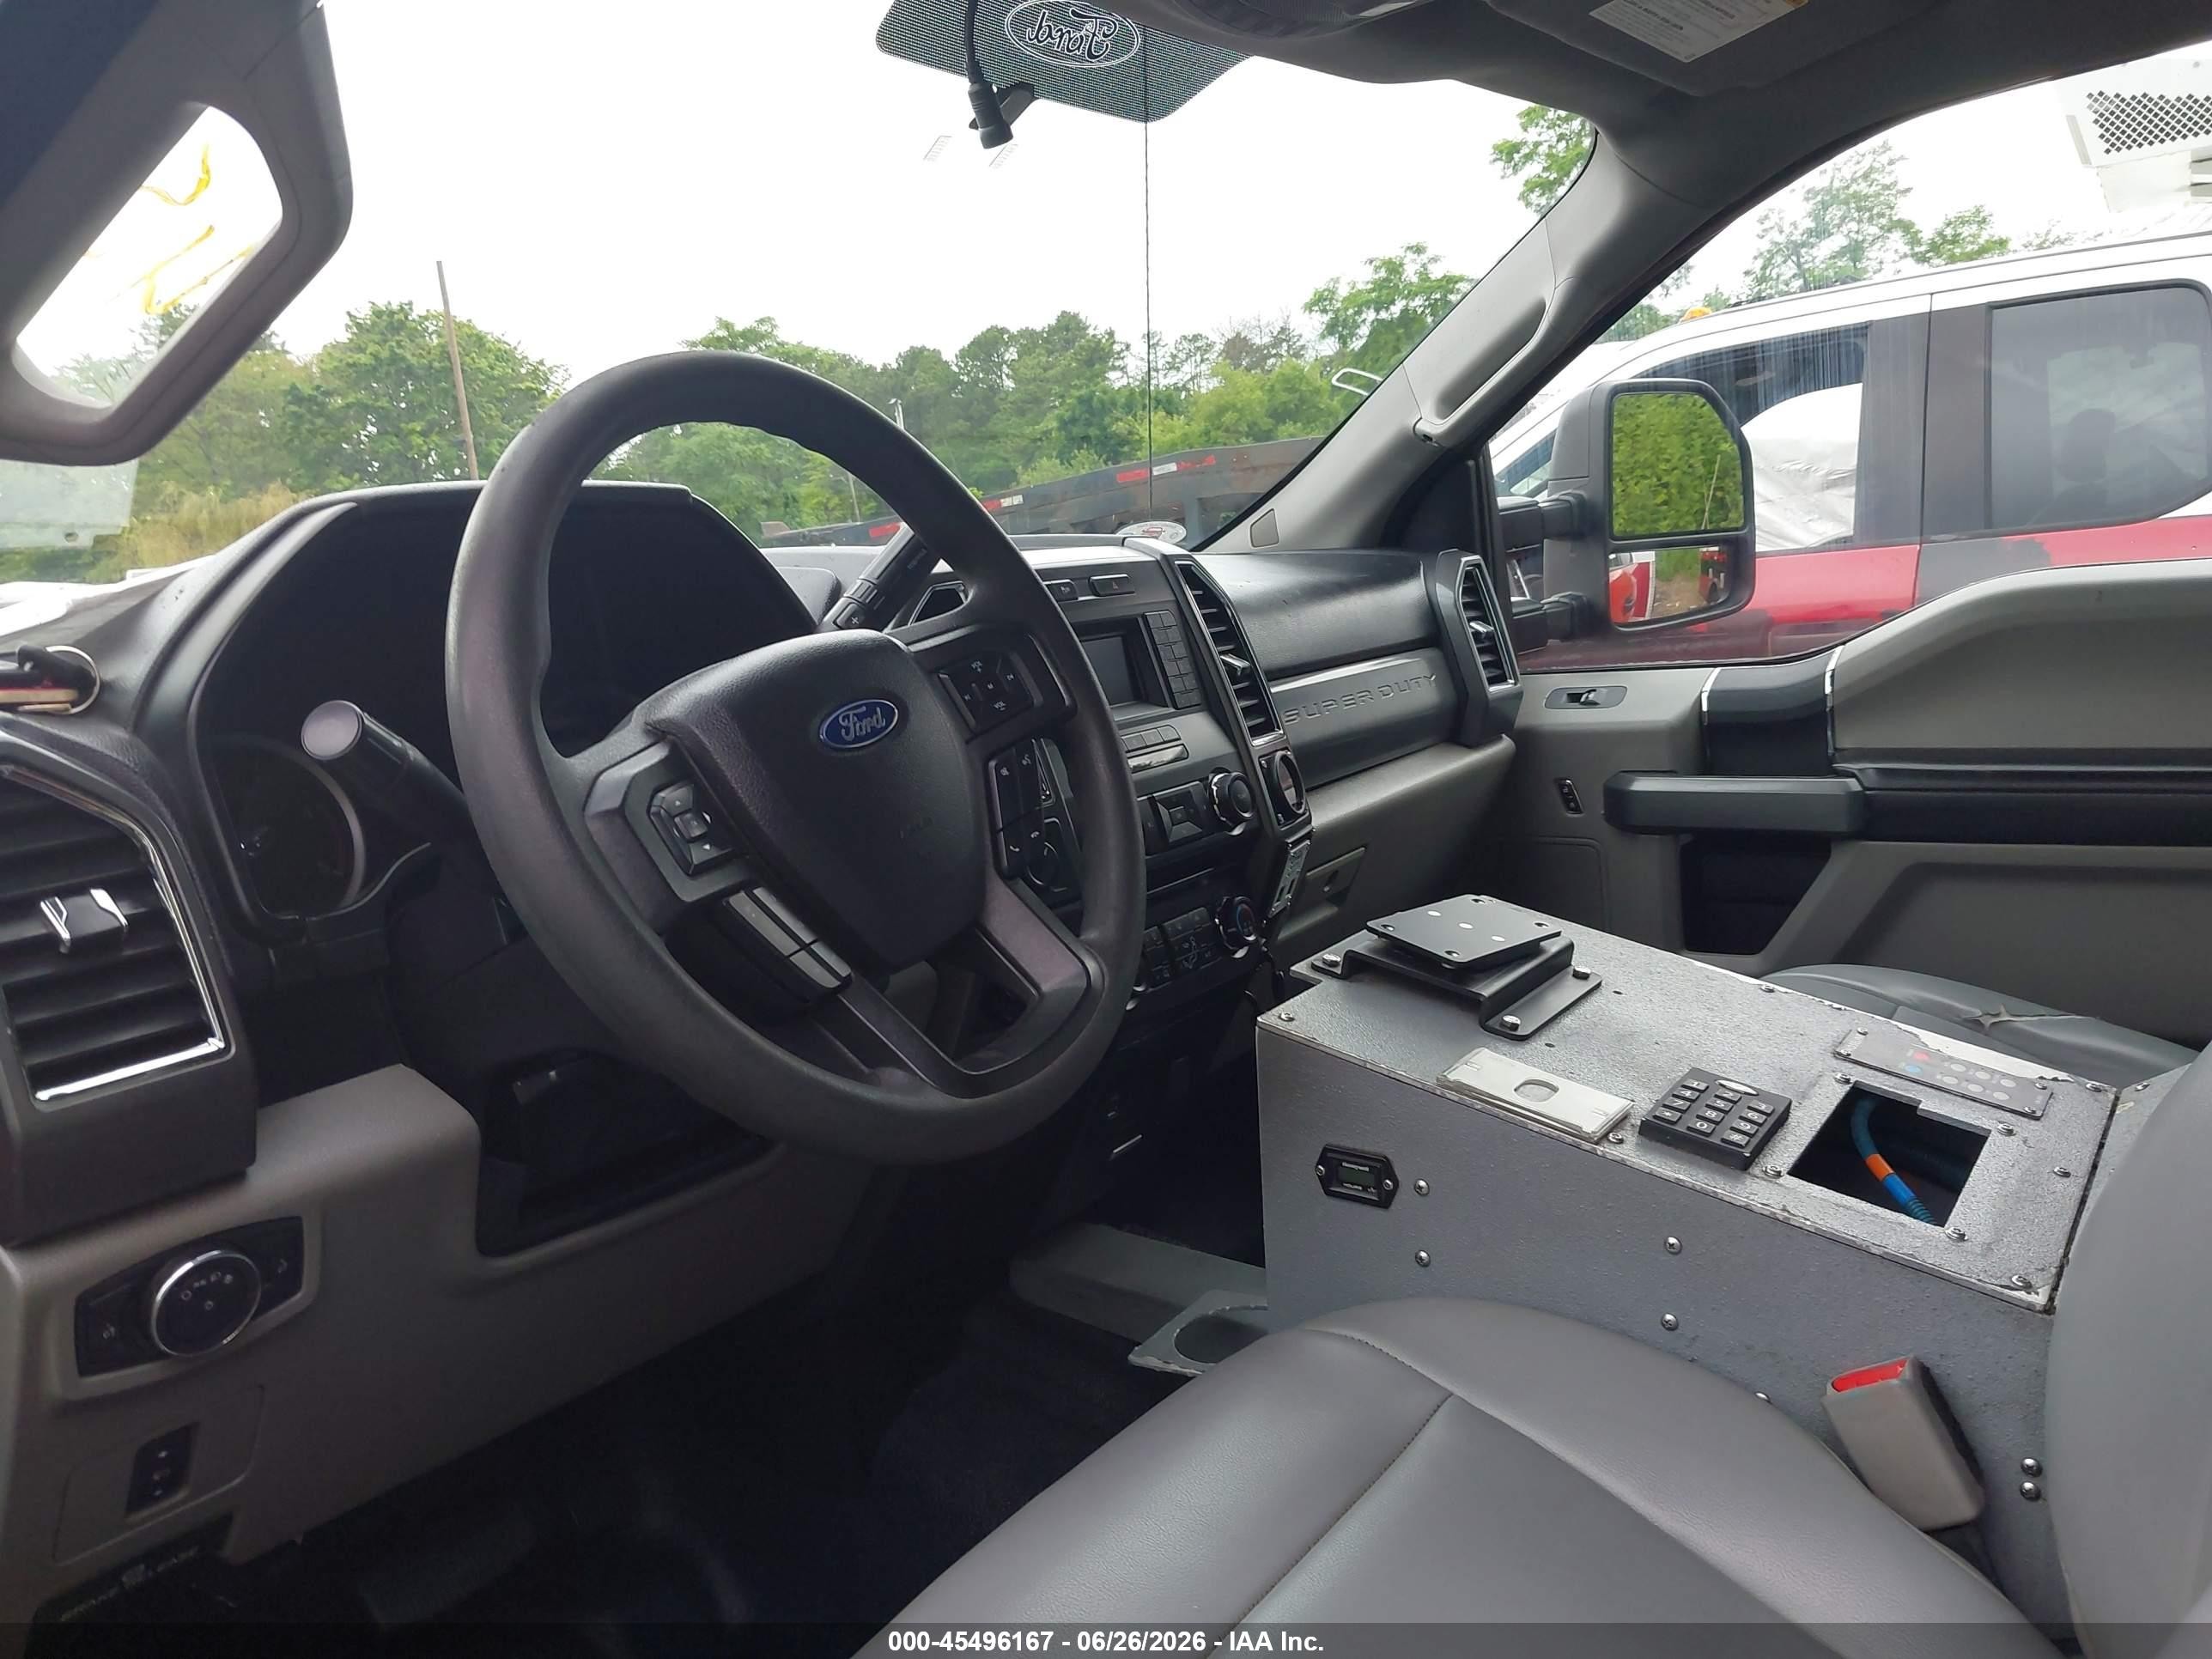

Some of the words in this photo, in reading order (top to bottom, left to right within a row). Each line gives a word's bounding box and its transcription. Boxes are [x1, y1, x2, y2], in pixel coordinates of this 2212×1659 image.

[1284, 690, 1375, 726] SUPER
[1377, 673, 1437, 700] DUTY
[839, 706, 886, 741] Ford
[1757, 1102, 1766, 1110] 3
